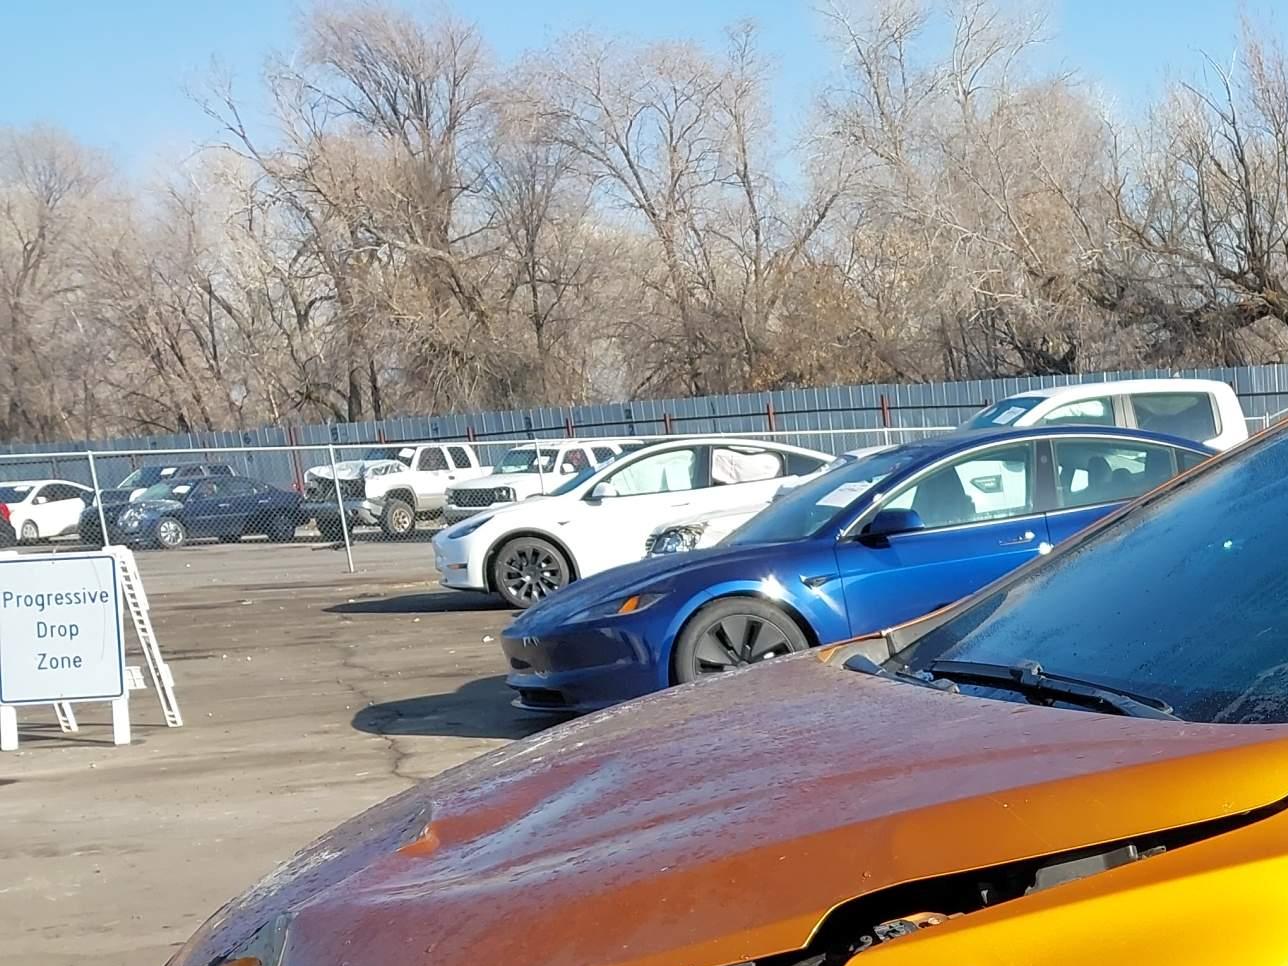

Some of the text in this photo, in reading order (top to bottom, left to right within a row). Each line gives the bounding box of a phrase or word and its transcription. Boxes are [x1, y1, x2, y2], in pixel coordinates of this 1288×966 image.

[2, 588, 109, 612] Progressive
[36, 621, 79, 640] Drop
[37, 652, 82, 670] Zone
